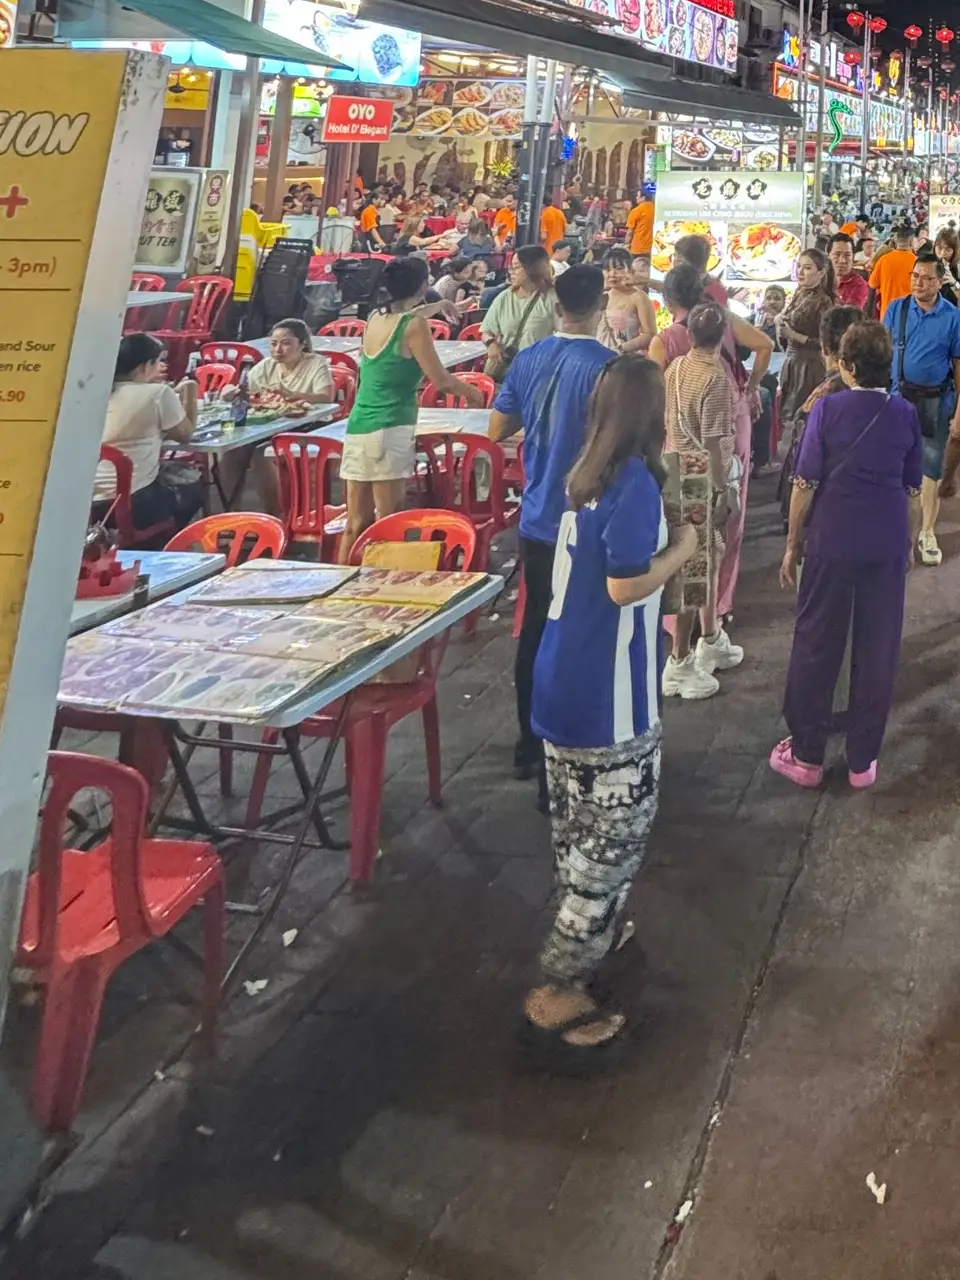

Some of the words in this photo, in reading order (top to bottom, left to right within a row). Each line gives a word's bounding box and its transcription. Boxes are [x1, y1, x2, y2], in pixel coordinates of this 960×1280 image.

[348, 104, 376, 120] OYO
[327, 123, 350, 135] Hotel
[360, 124, 388, 137] Elegant
[8, 256, 57, 279] 3pm)
[25, 340, 56, 352] Sour
[17, 360, 42, 372] rice
